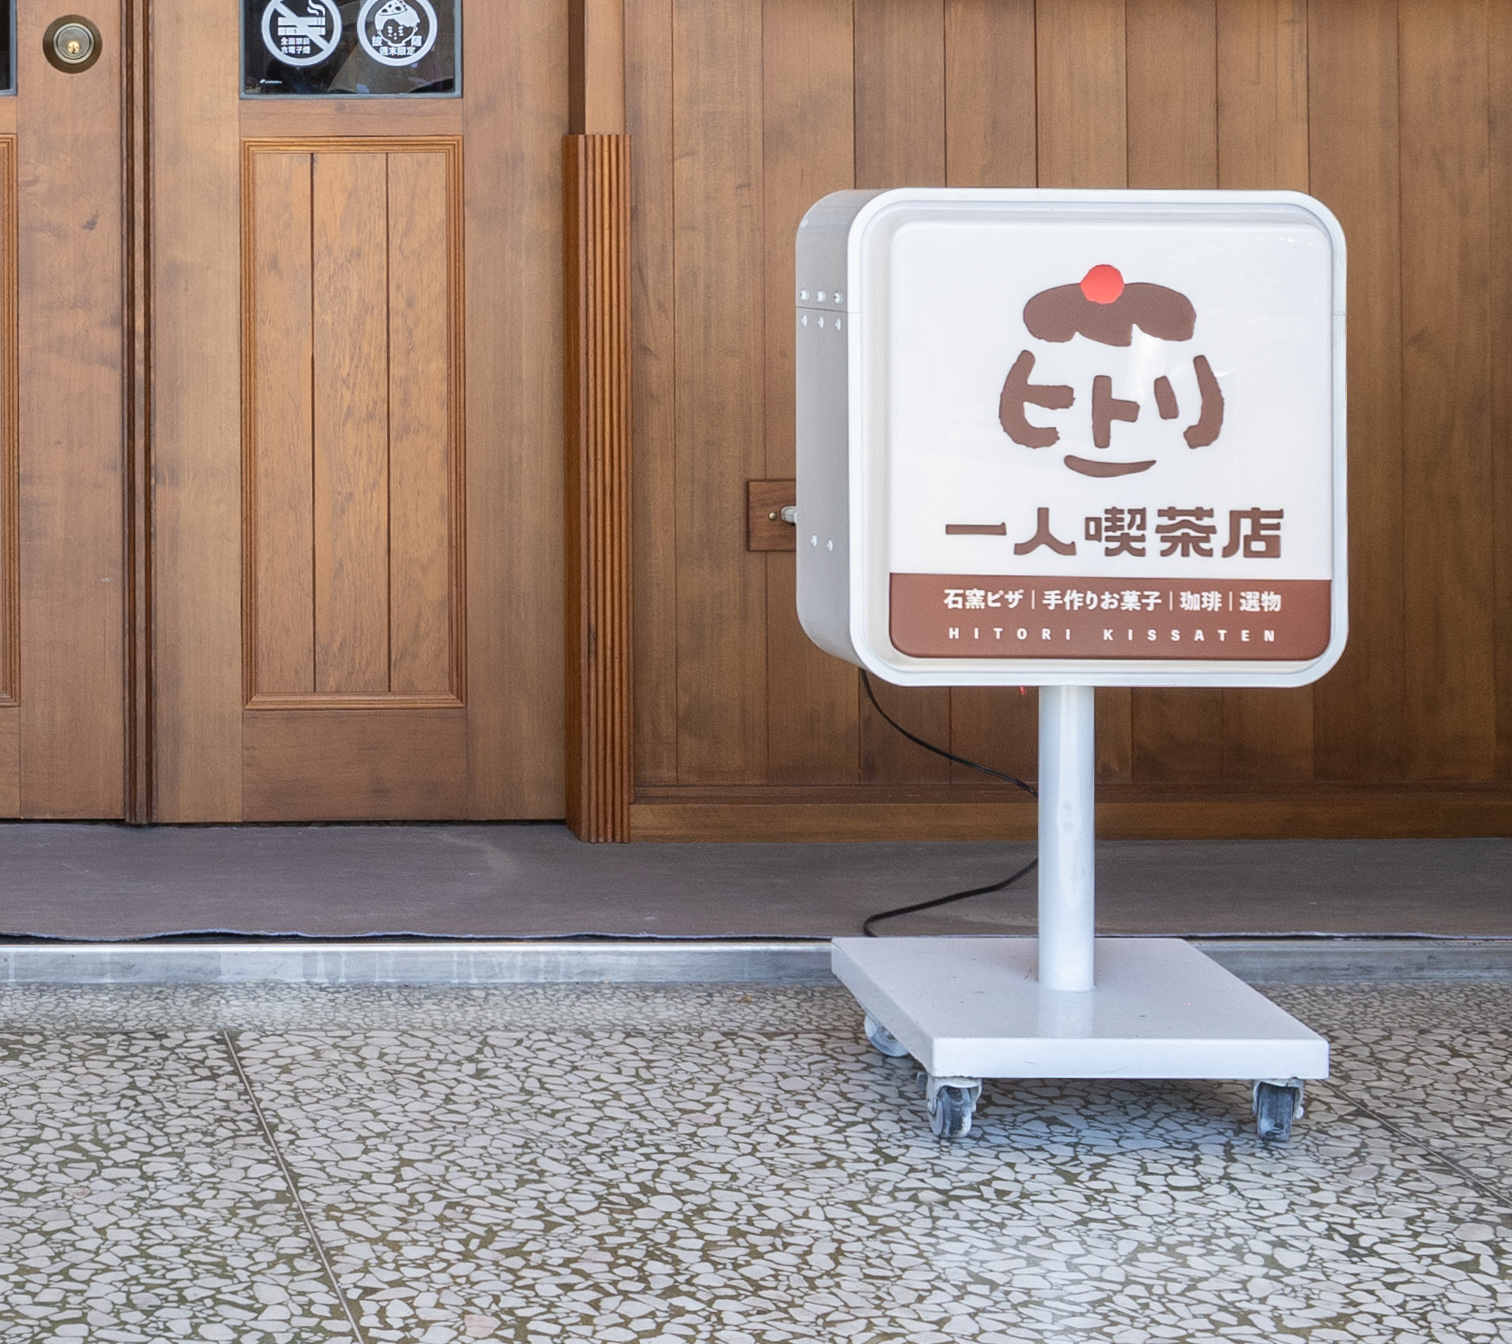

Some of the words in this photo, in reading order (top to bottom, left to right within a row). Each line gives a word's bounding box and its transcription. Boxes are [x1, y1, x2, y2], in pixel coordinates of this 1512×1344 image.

[998, 349, 1225, 450] ヒトリ
[945, 506, 1285, 559] 一人喫茶店
[943, 588, 1024, 610] 石窯ピザ
[1042, 589, 1163, 612] 手作りお菓子
[1179, 590, 1223, 612] 珈琲
[1239, 590, 1283, 612] 選物
[948, 627, 1071, 641] HITORI
[1103, 629, 1275, 642] KISSATEN
